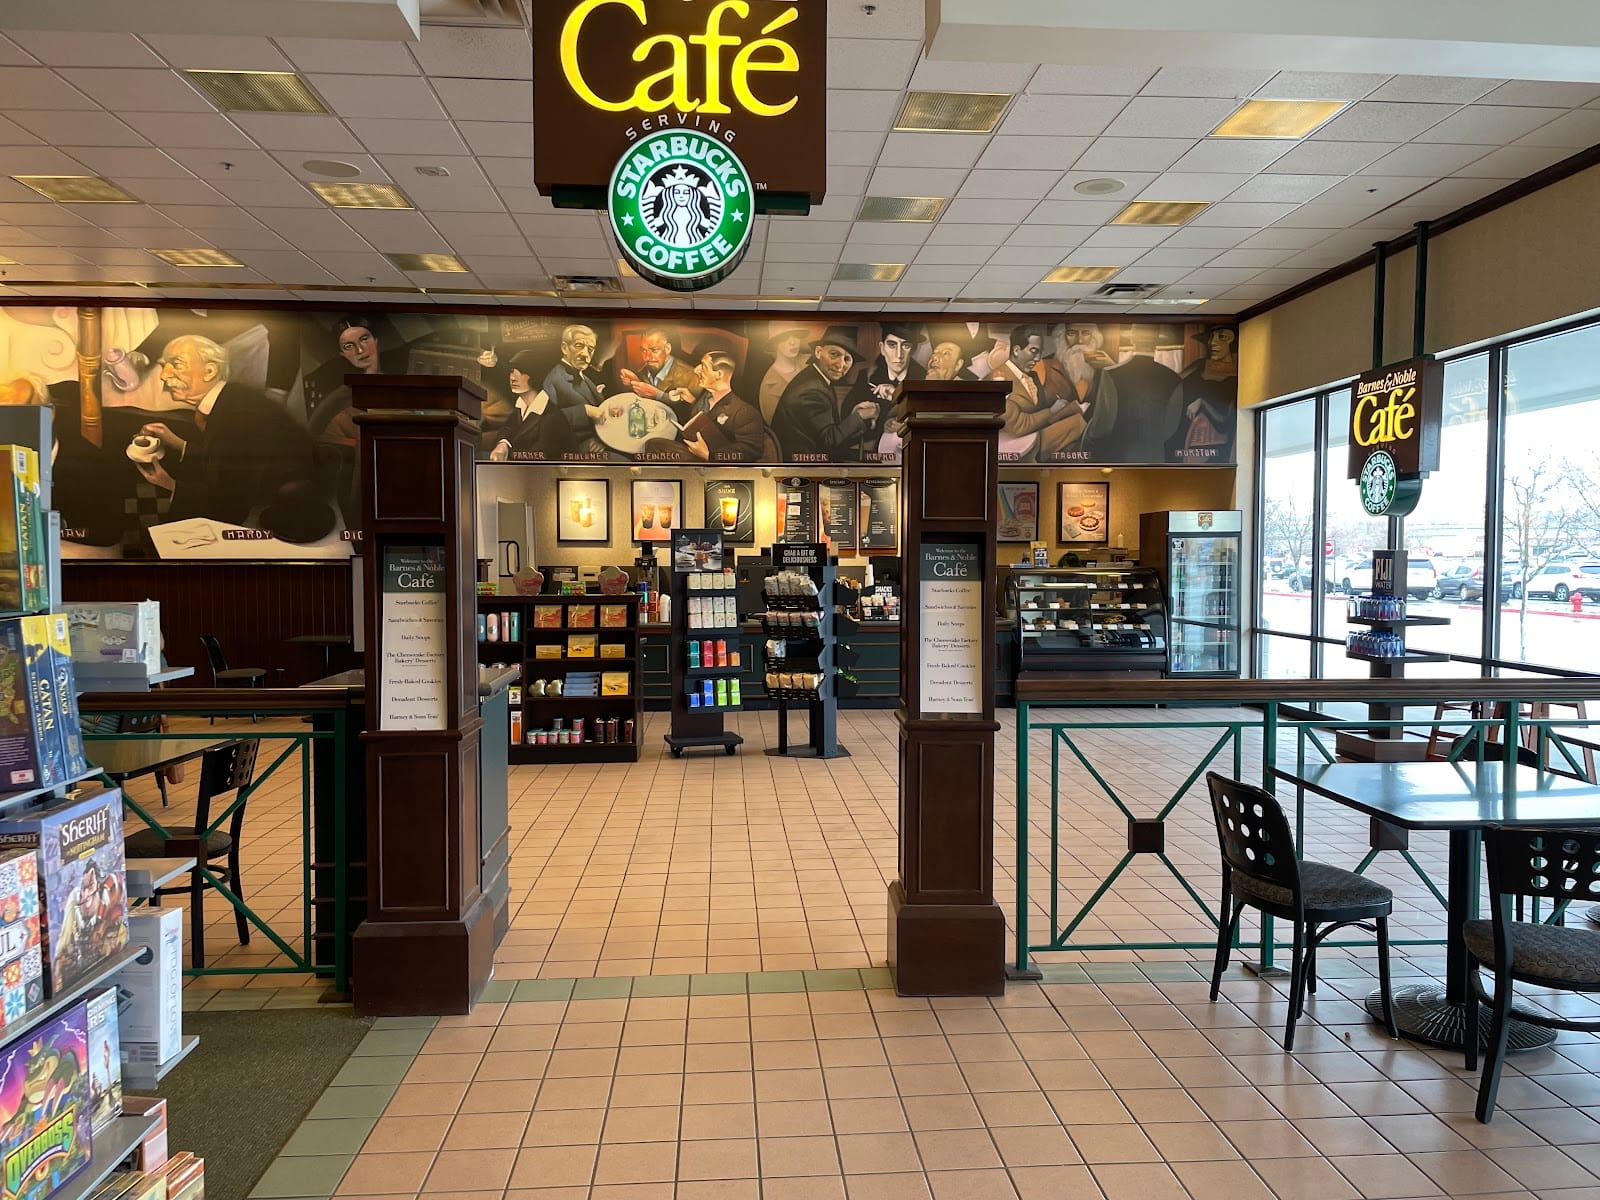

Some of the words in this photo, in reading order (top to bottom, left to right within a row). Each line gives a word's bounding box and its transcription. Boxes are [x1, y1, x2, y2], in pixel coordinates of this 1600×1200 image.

[560, 0, 800, 117] Café
[625, 112, 736, 143] SERVING
[616, 136, 746, 200] STARBUCKS
[635, 234, 734, 272] COFFEE
[1357, 378, 1385, 395] Barnes
[1384, 372, 1393, 394] &
[1392, 368, 1417, 387] Noble
[1353, 387, 1416, 447] Café
[717, 452, 743, 461] ELIOT
[1362, 453, 1396, 482] STARBUCKS
[1364, 495, 1390, 513] COFFEE
[226, 530, 271, 540] HARDY
[389, 563, 416, 571] Barnes
[925, 552, 950, 561] Barnes
[397, 572, 435, 588] Café
[933, 561, 968, 577] Café
[1375, 558, 1393, 580] FIJI
[1375, 581, 1392, 590] WATER
[39, 678, 55, 730] CATAN
